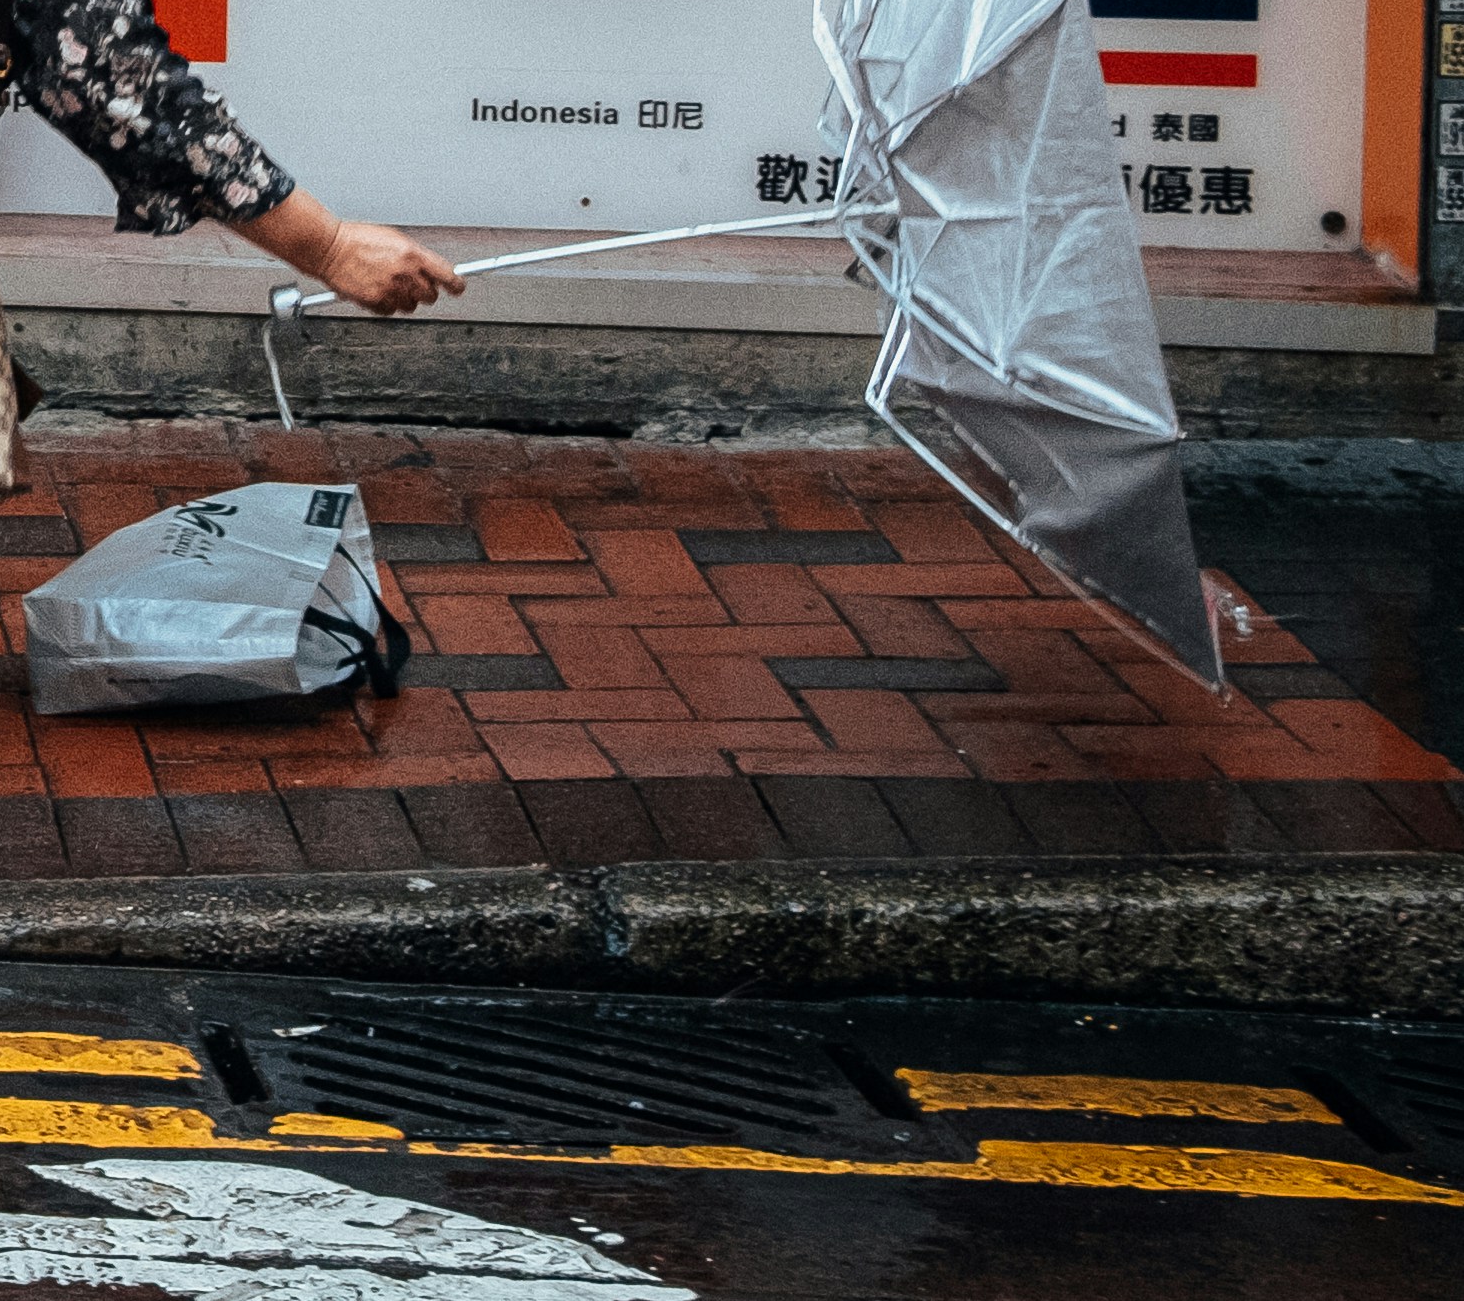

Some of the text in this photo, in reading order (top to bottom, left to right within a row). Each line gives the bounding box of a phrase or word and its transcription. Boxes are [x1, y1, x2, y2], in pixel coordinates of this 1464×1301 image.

[471, 98, 705, 131] Indonesia 印尼
[1151, 112, 1220, 143] 泰國
[1119, 163, 1255, 216] 優惠
